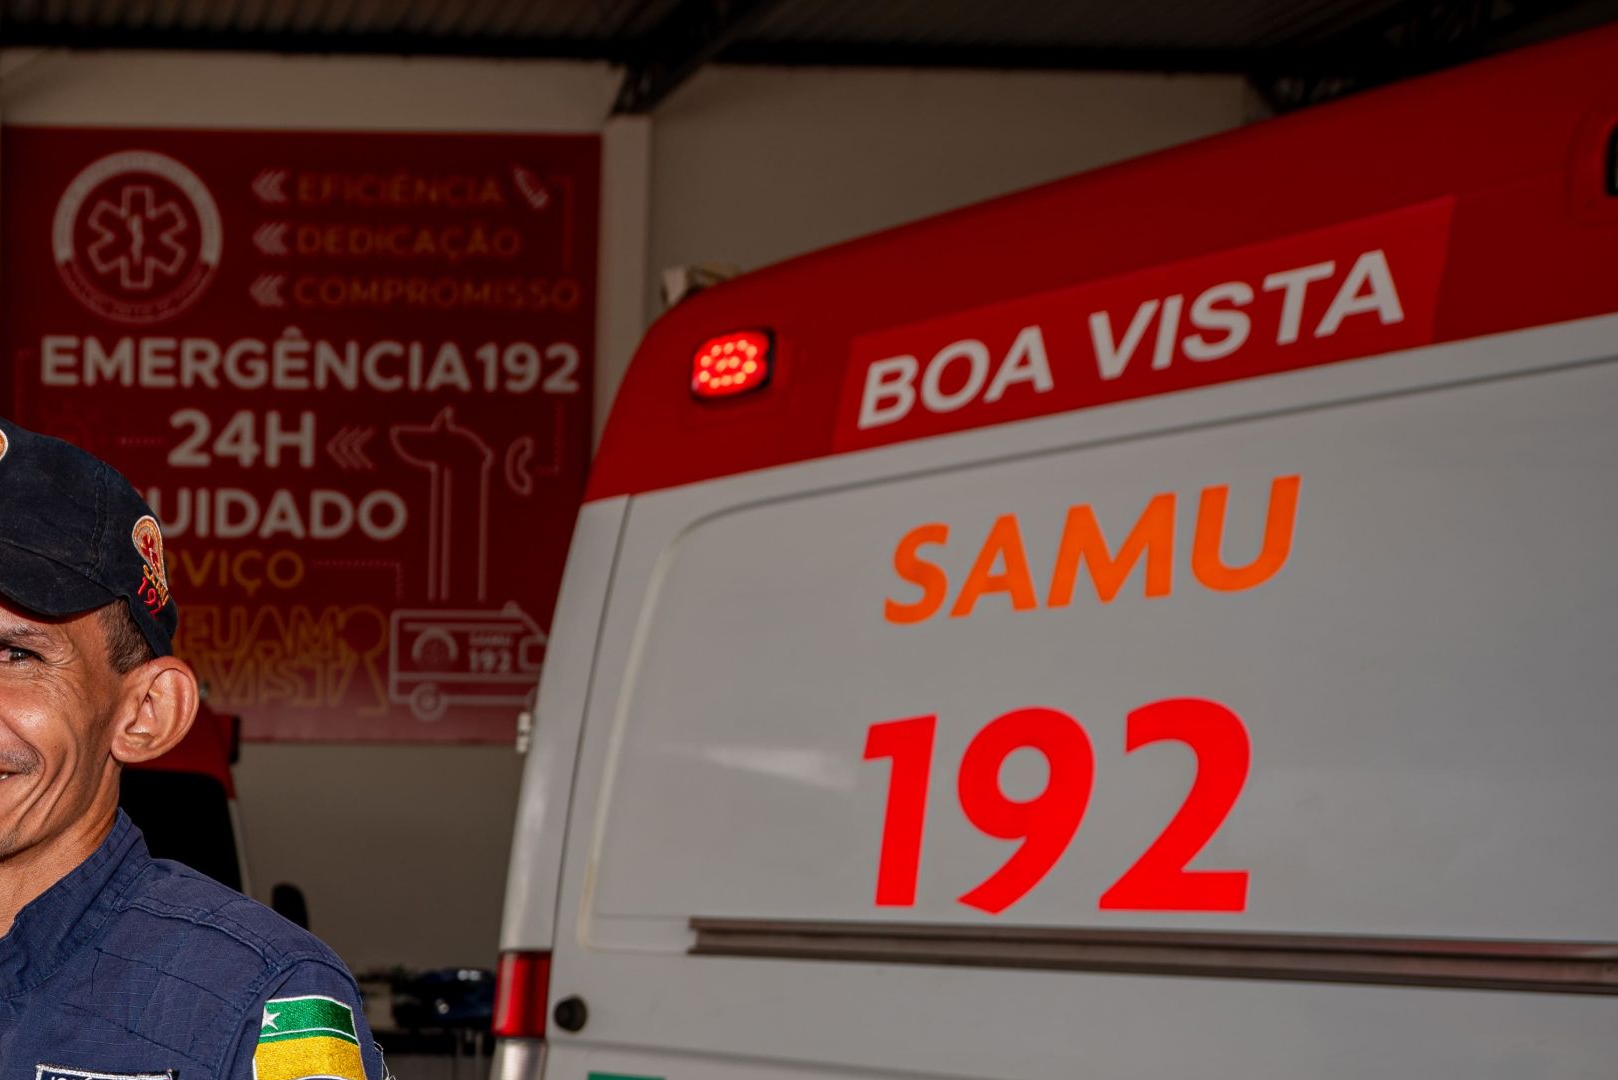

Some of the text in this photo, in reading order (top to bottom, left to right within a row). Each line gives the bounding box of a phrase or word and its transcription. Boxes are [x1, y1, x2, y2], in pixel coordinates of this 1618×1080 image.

[297, 223, 521, 262] DEDICAÇÃO
[295, 277, 580, 310] COMPROMISSO
[856, 249, 1406, 429] BOA VISTA
[167, 409, 315, 469] 24H
[141, 488, 408, 540] UIDADO
[882, 473, 1303, 624] SAMU
[863, 696, 1252, 914] 192
